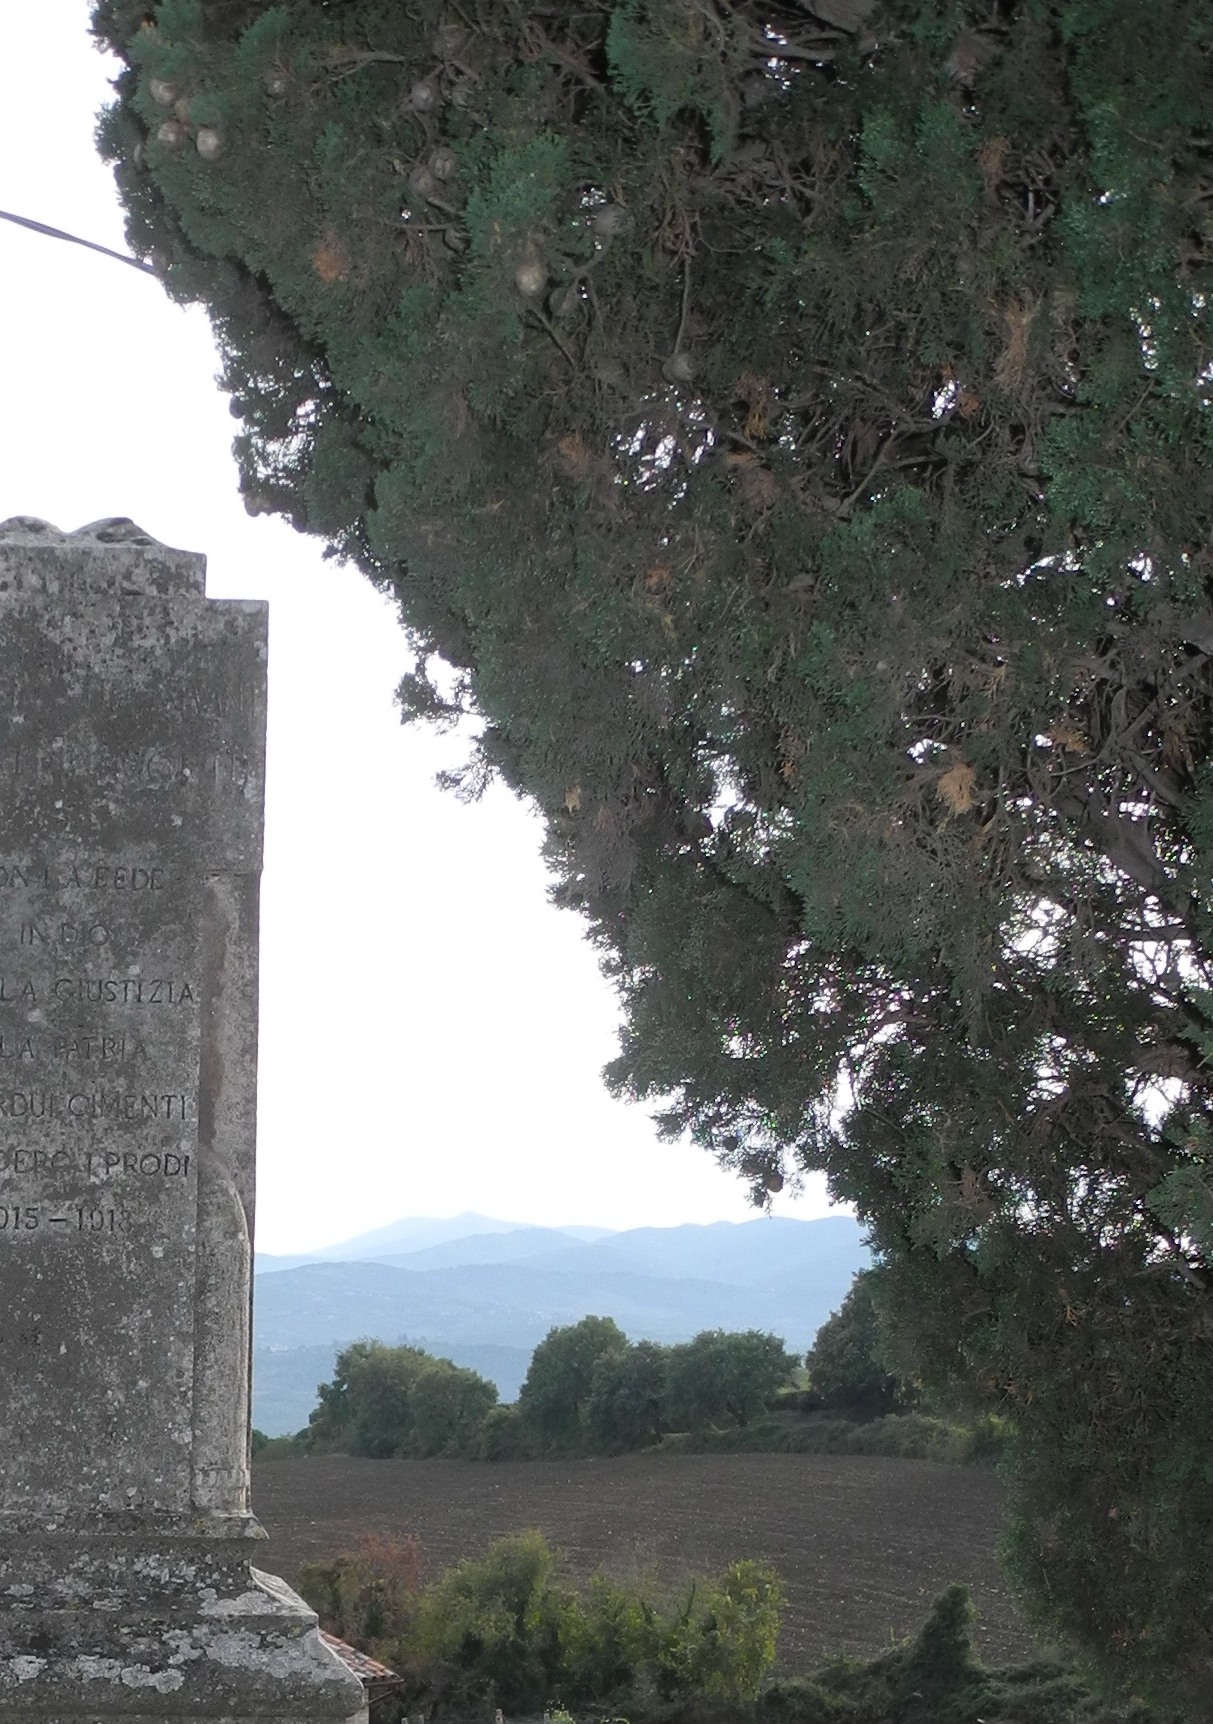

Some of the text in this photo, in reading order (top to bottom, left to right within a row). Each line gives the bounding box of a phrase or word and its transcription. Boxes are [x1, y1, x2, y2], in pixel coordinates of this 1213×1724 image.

[20, 922, 47, 946] IN
[0, 978, 36, 1001] LA
[54, 978, 194, 1003] GIUSTIZIA
[0, 1034, 34, 1059] LA
[54, 1036, 148, 1061] PATRIA
[68, 1093, 188, 1119] CIMENTI
[104, 1153, 190, 1177] PRODI
